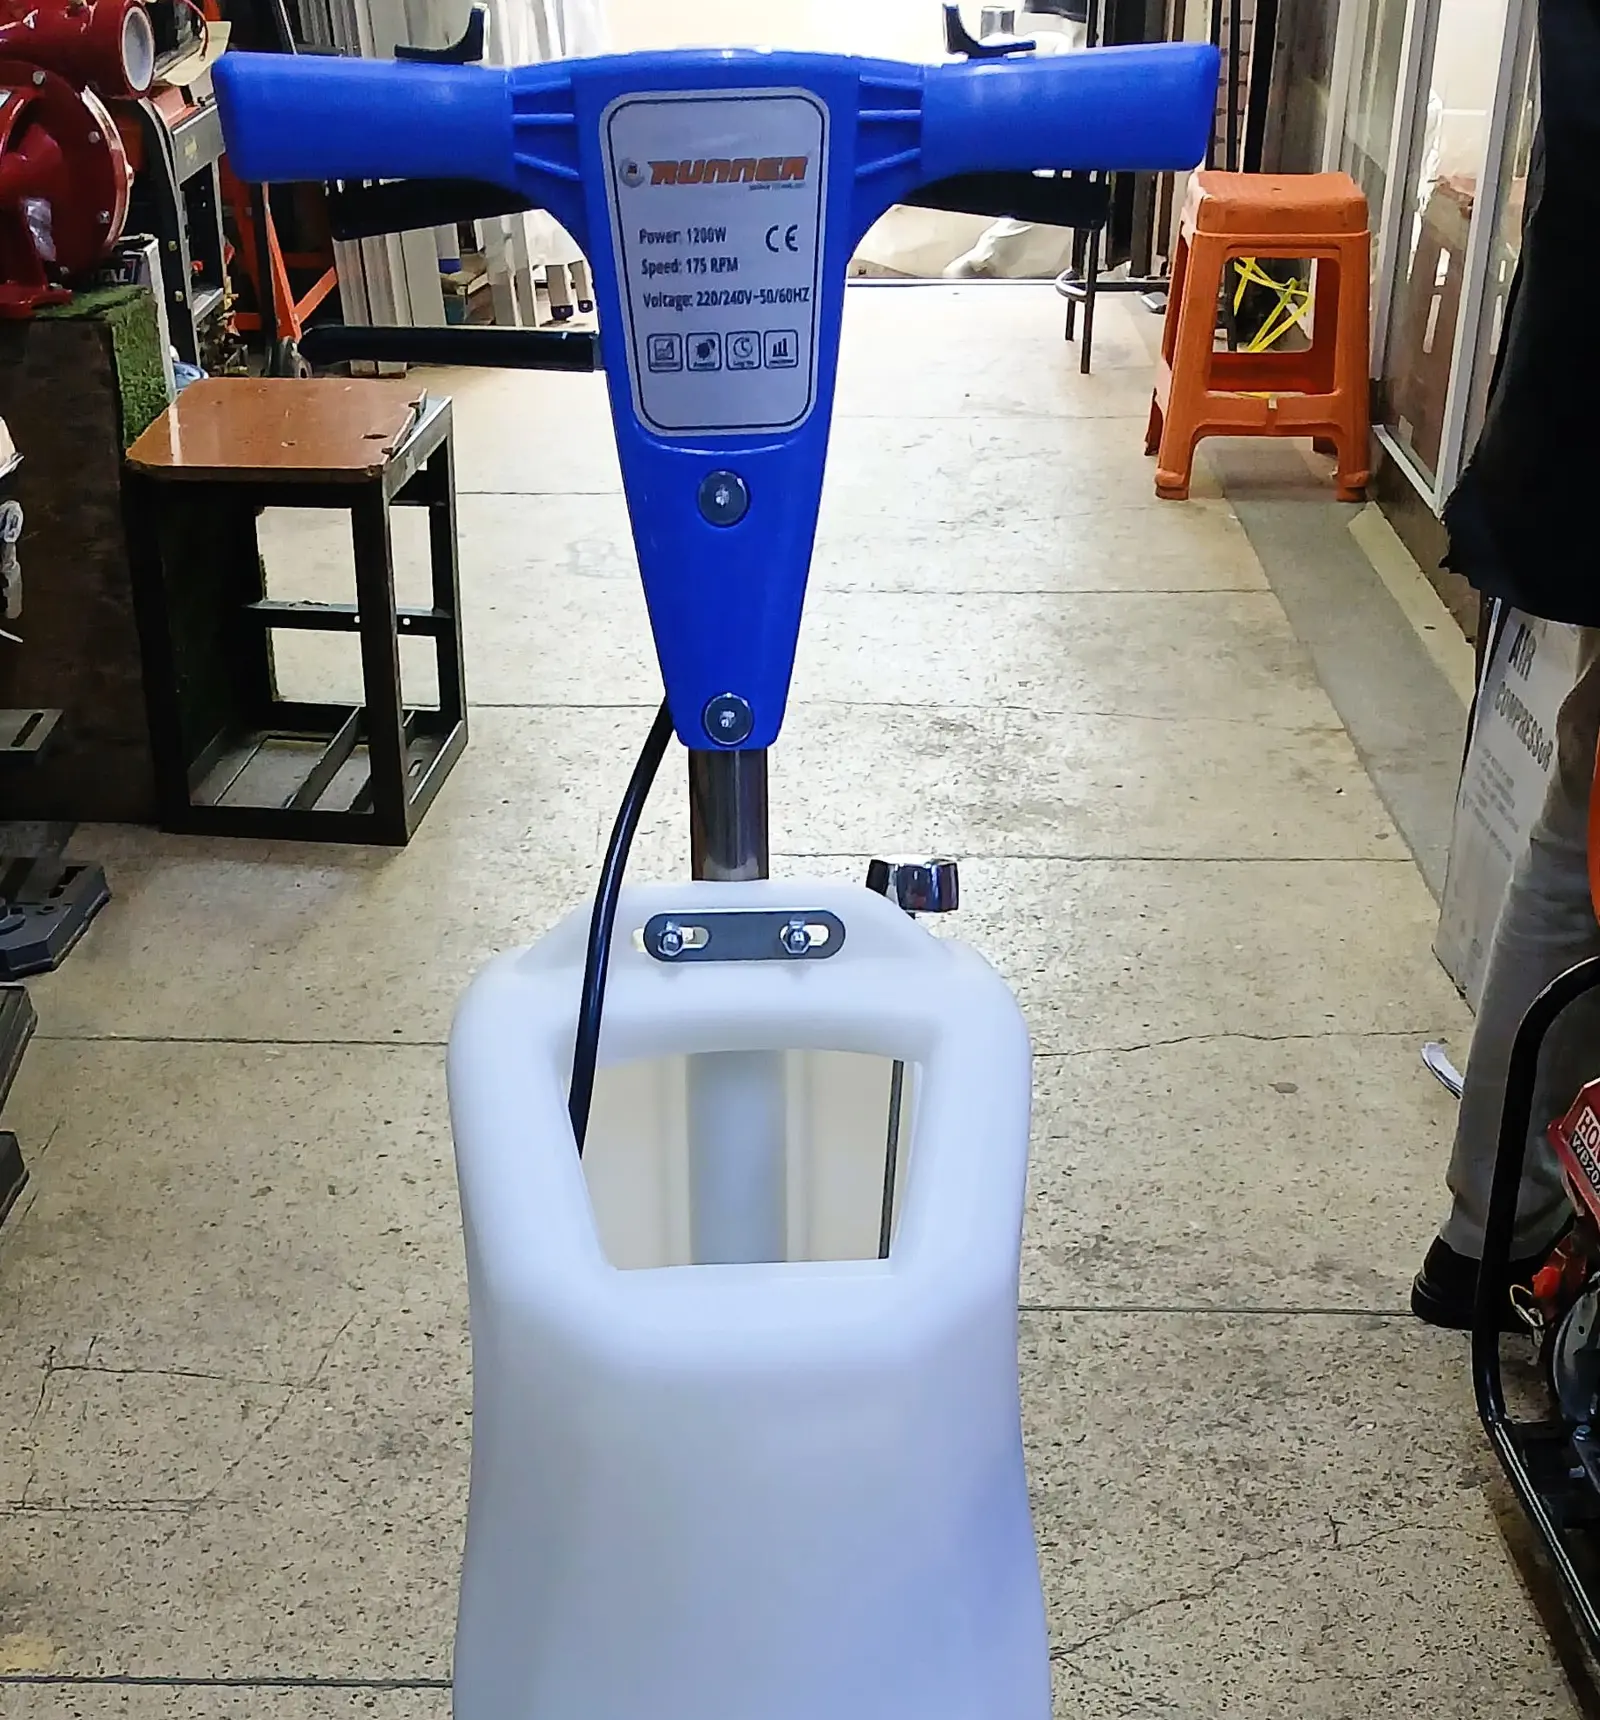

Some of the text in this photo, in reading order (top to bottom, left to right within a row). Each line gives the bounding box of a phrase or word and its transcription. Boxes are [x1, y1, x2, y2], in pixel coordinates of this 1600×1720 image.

[647, 156, 808, 185] RUNNER
[639, 227, 727, 244] Power: 1200W
[641, 257, 738, 278] Speed: 175 RPM
[643, 293, 693, 311] Voltage:
[1508, 623, 1537, 681] AIR
